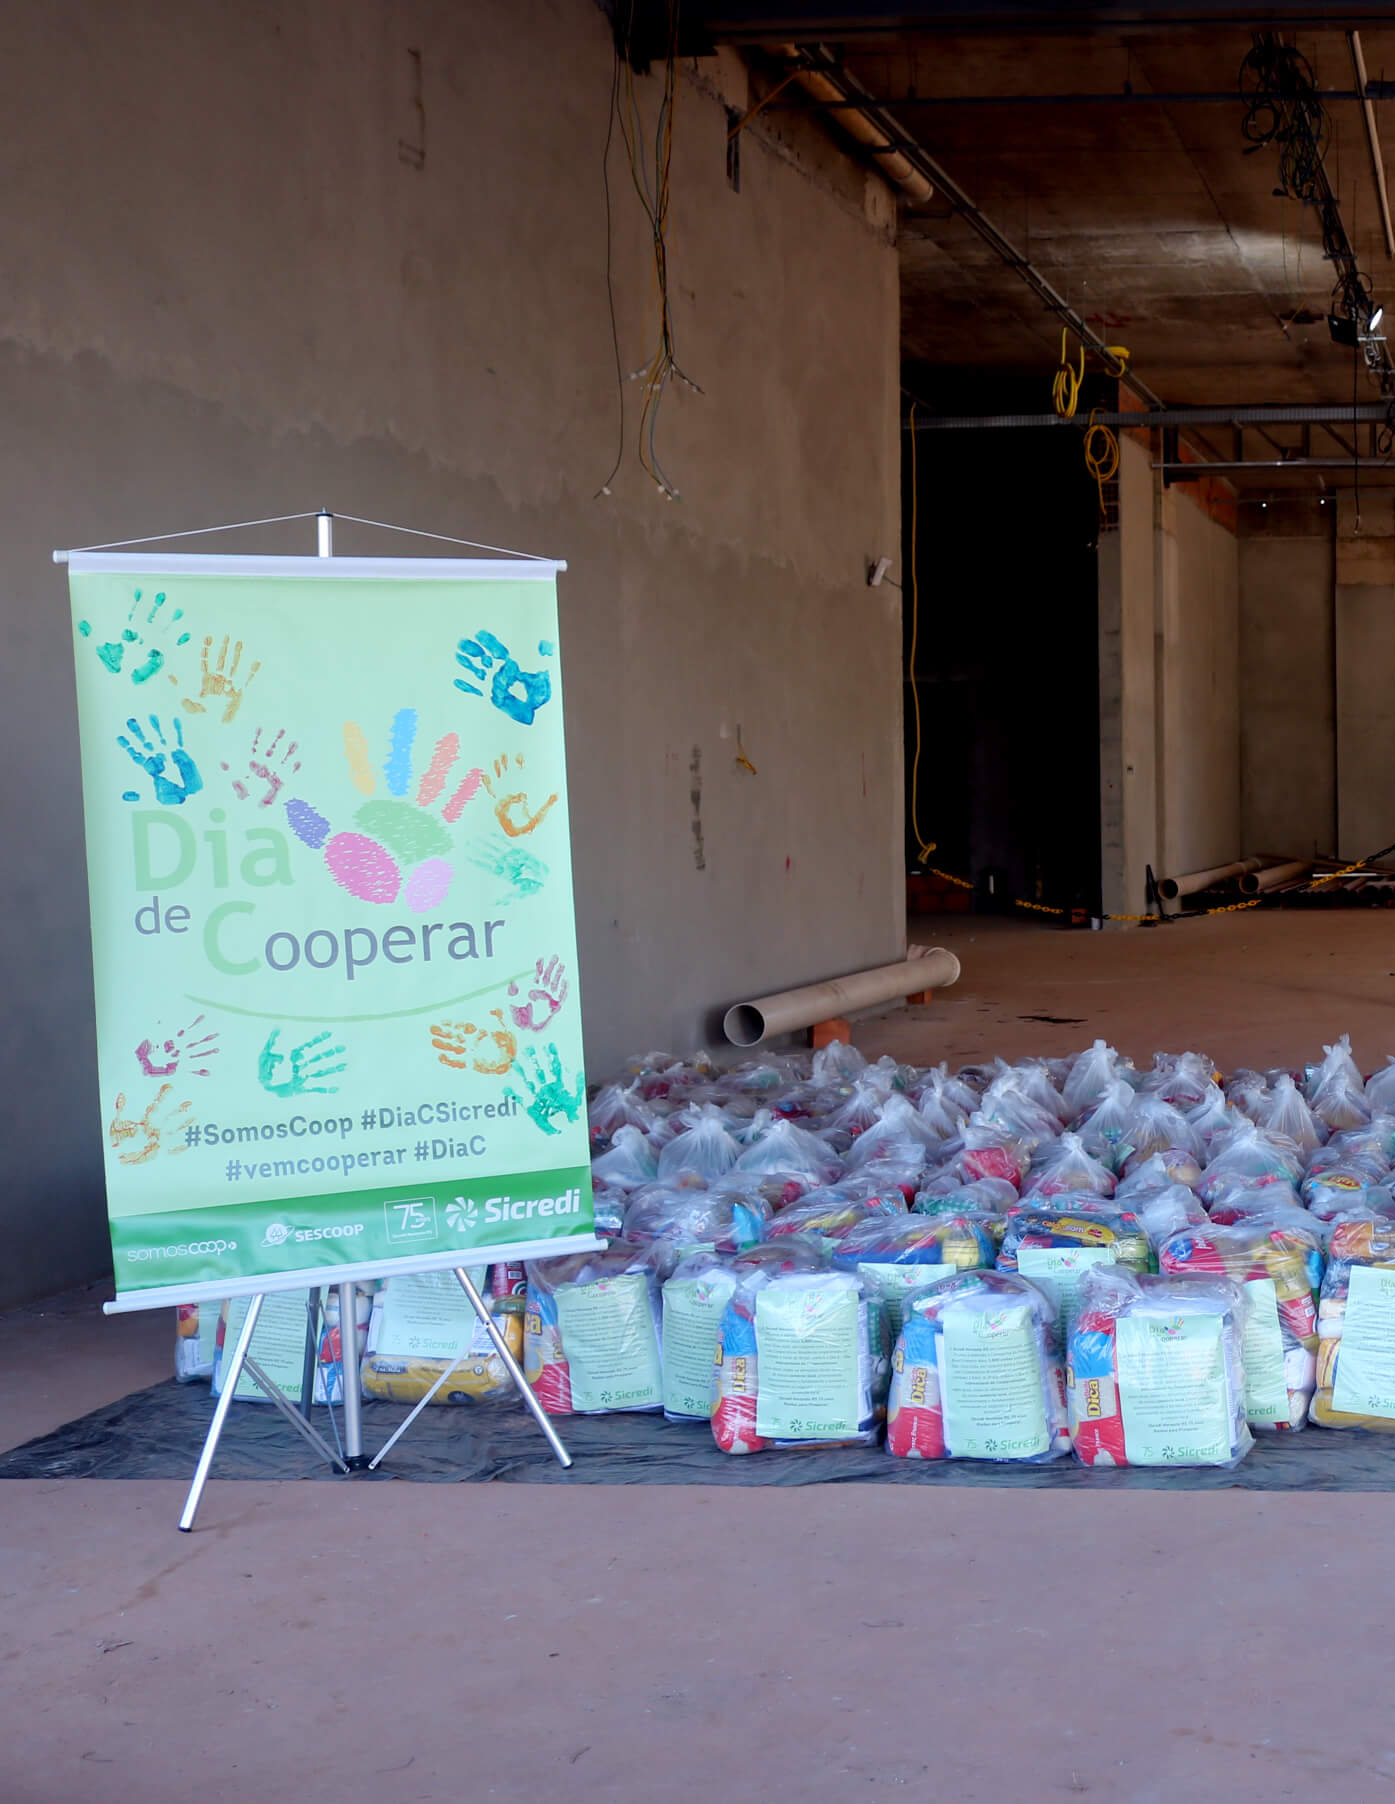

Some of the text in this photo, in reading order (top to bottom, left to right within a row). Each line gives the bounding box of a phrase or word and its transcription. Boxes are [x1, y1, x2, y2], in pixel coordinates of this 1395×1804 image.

[131, 807, 296, 892] Dia
[134, 895, 506, 980] de Cooperar
[184, 1095, 519, 1148] #SomosCoop #DiaCSicredi
[225, 1135, 487, 1182] #vemcooperar #DiaC
[294, 1223, 365, 1242] SESCOOP
[392, 1202, 426, 1231] 75
[484, 1188, 581, 1224] Sicredi
[614, 1388, 653, 1401] Sicredi
[911, 1367, 928, 1404] Dica
[1086, 1378, 1102, 1418] Dica
[805, 1420, 847, 1432] Sicredi
[999, 1435, 1041, 1450] Sicredi
[1177, 1443, 1219, 1458] Sicredi
